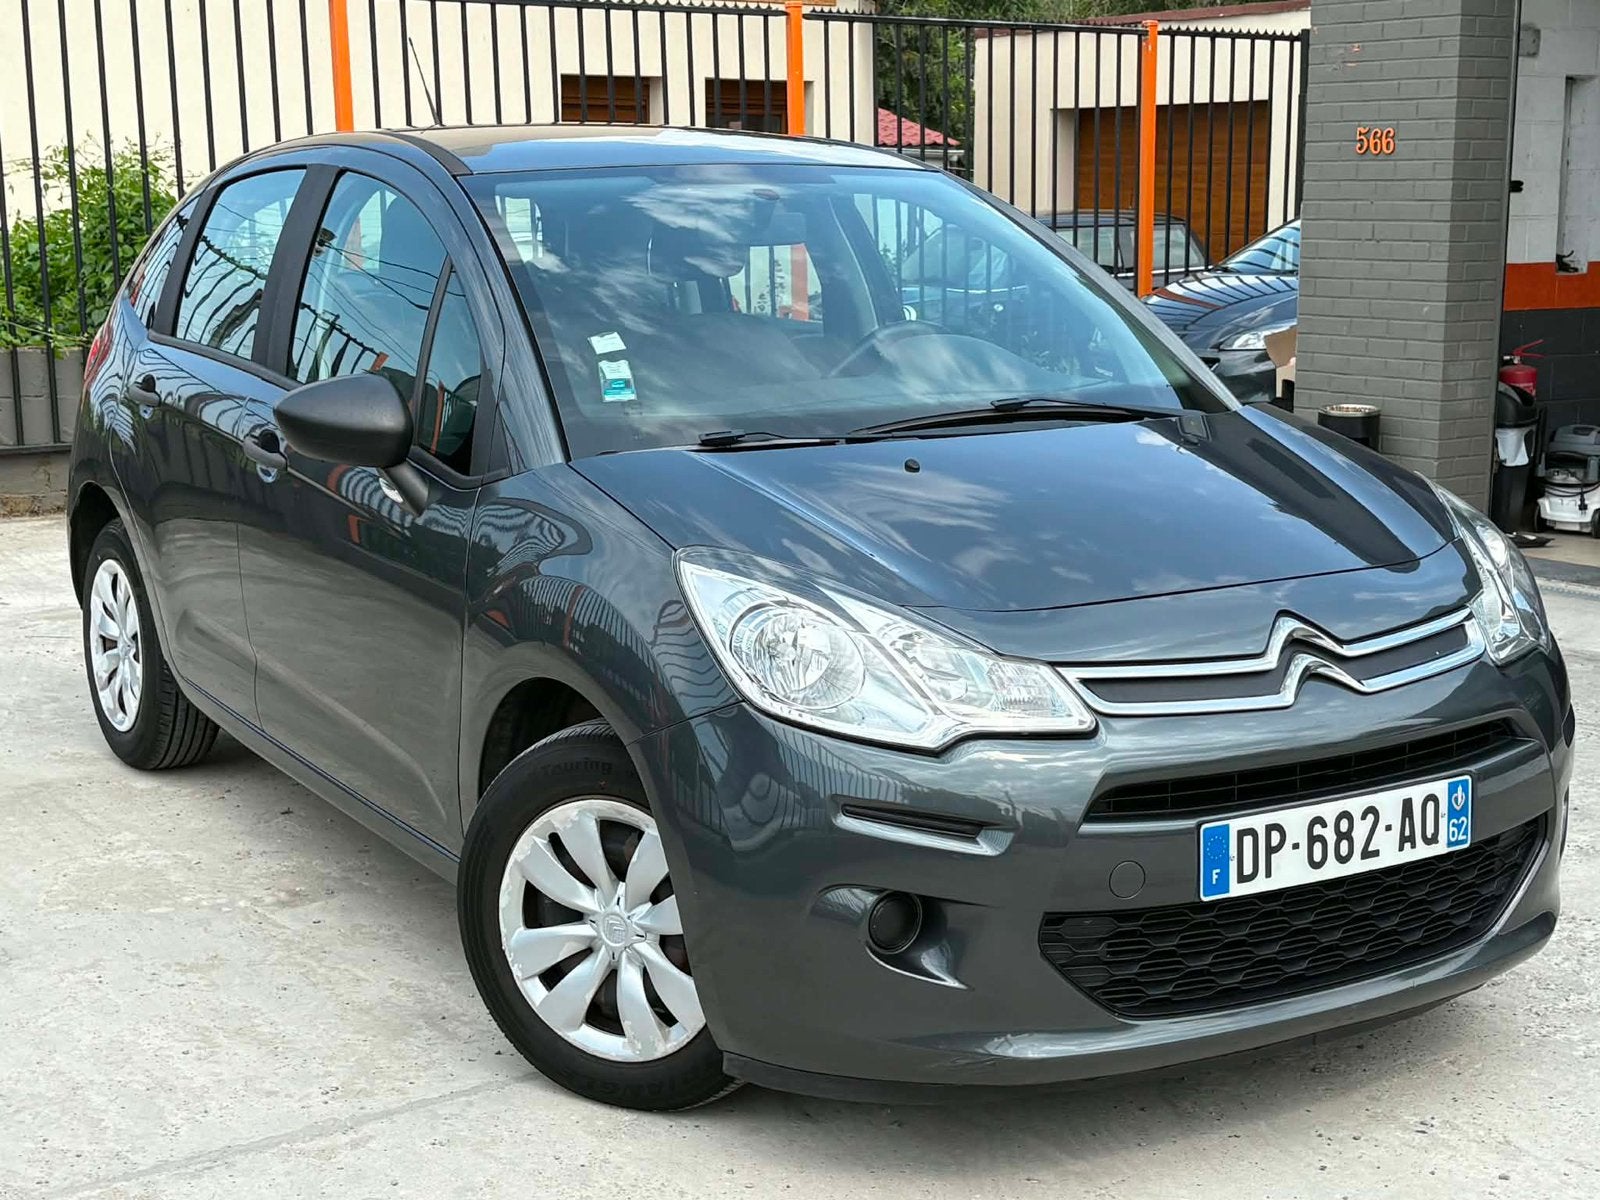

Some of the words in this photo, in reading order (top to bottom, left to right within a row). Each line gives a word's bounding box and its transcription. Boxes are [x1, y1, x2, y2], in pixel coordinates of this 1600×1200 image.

[1355, 126, 1396, 155] 566
[541, 757, 613, 776] Touring
[1212, 868, 1221, 885] F
[1236, 793, 1440, 884] DP-682-AQ
[1449, 816, 1468, 842] 62
